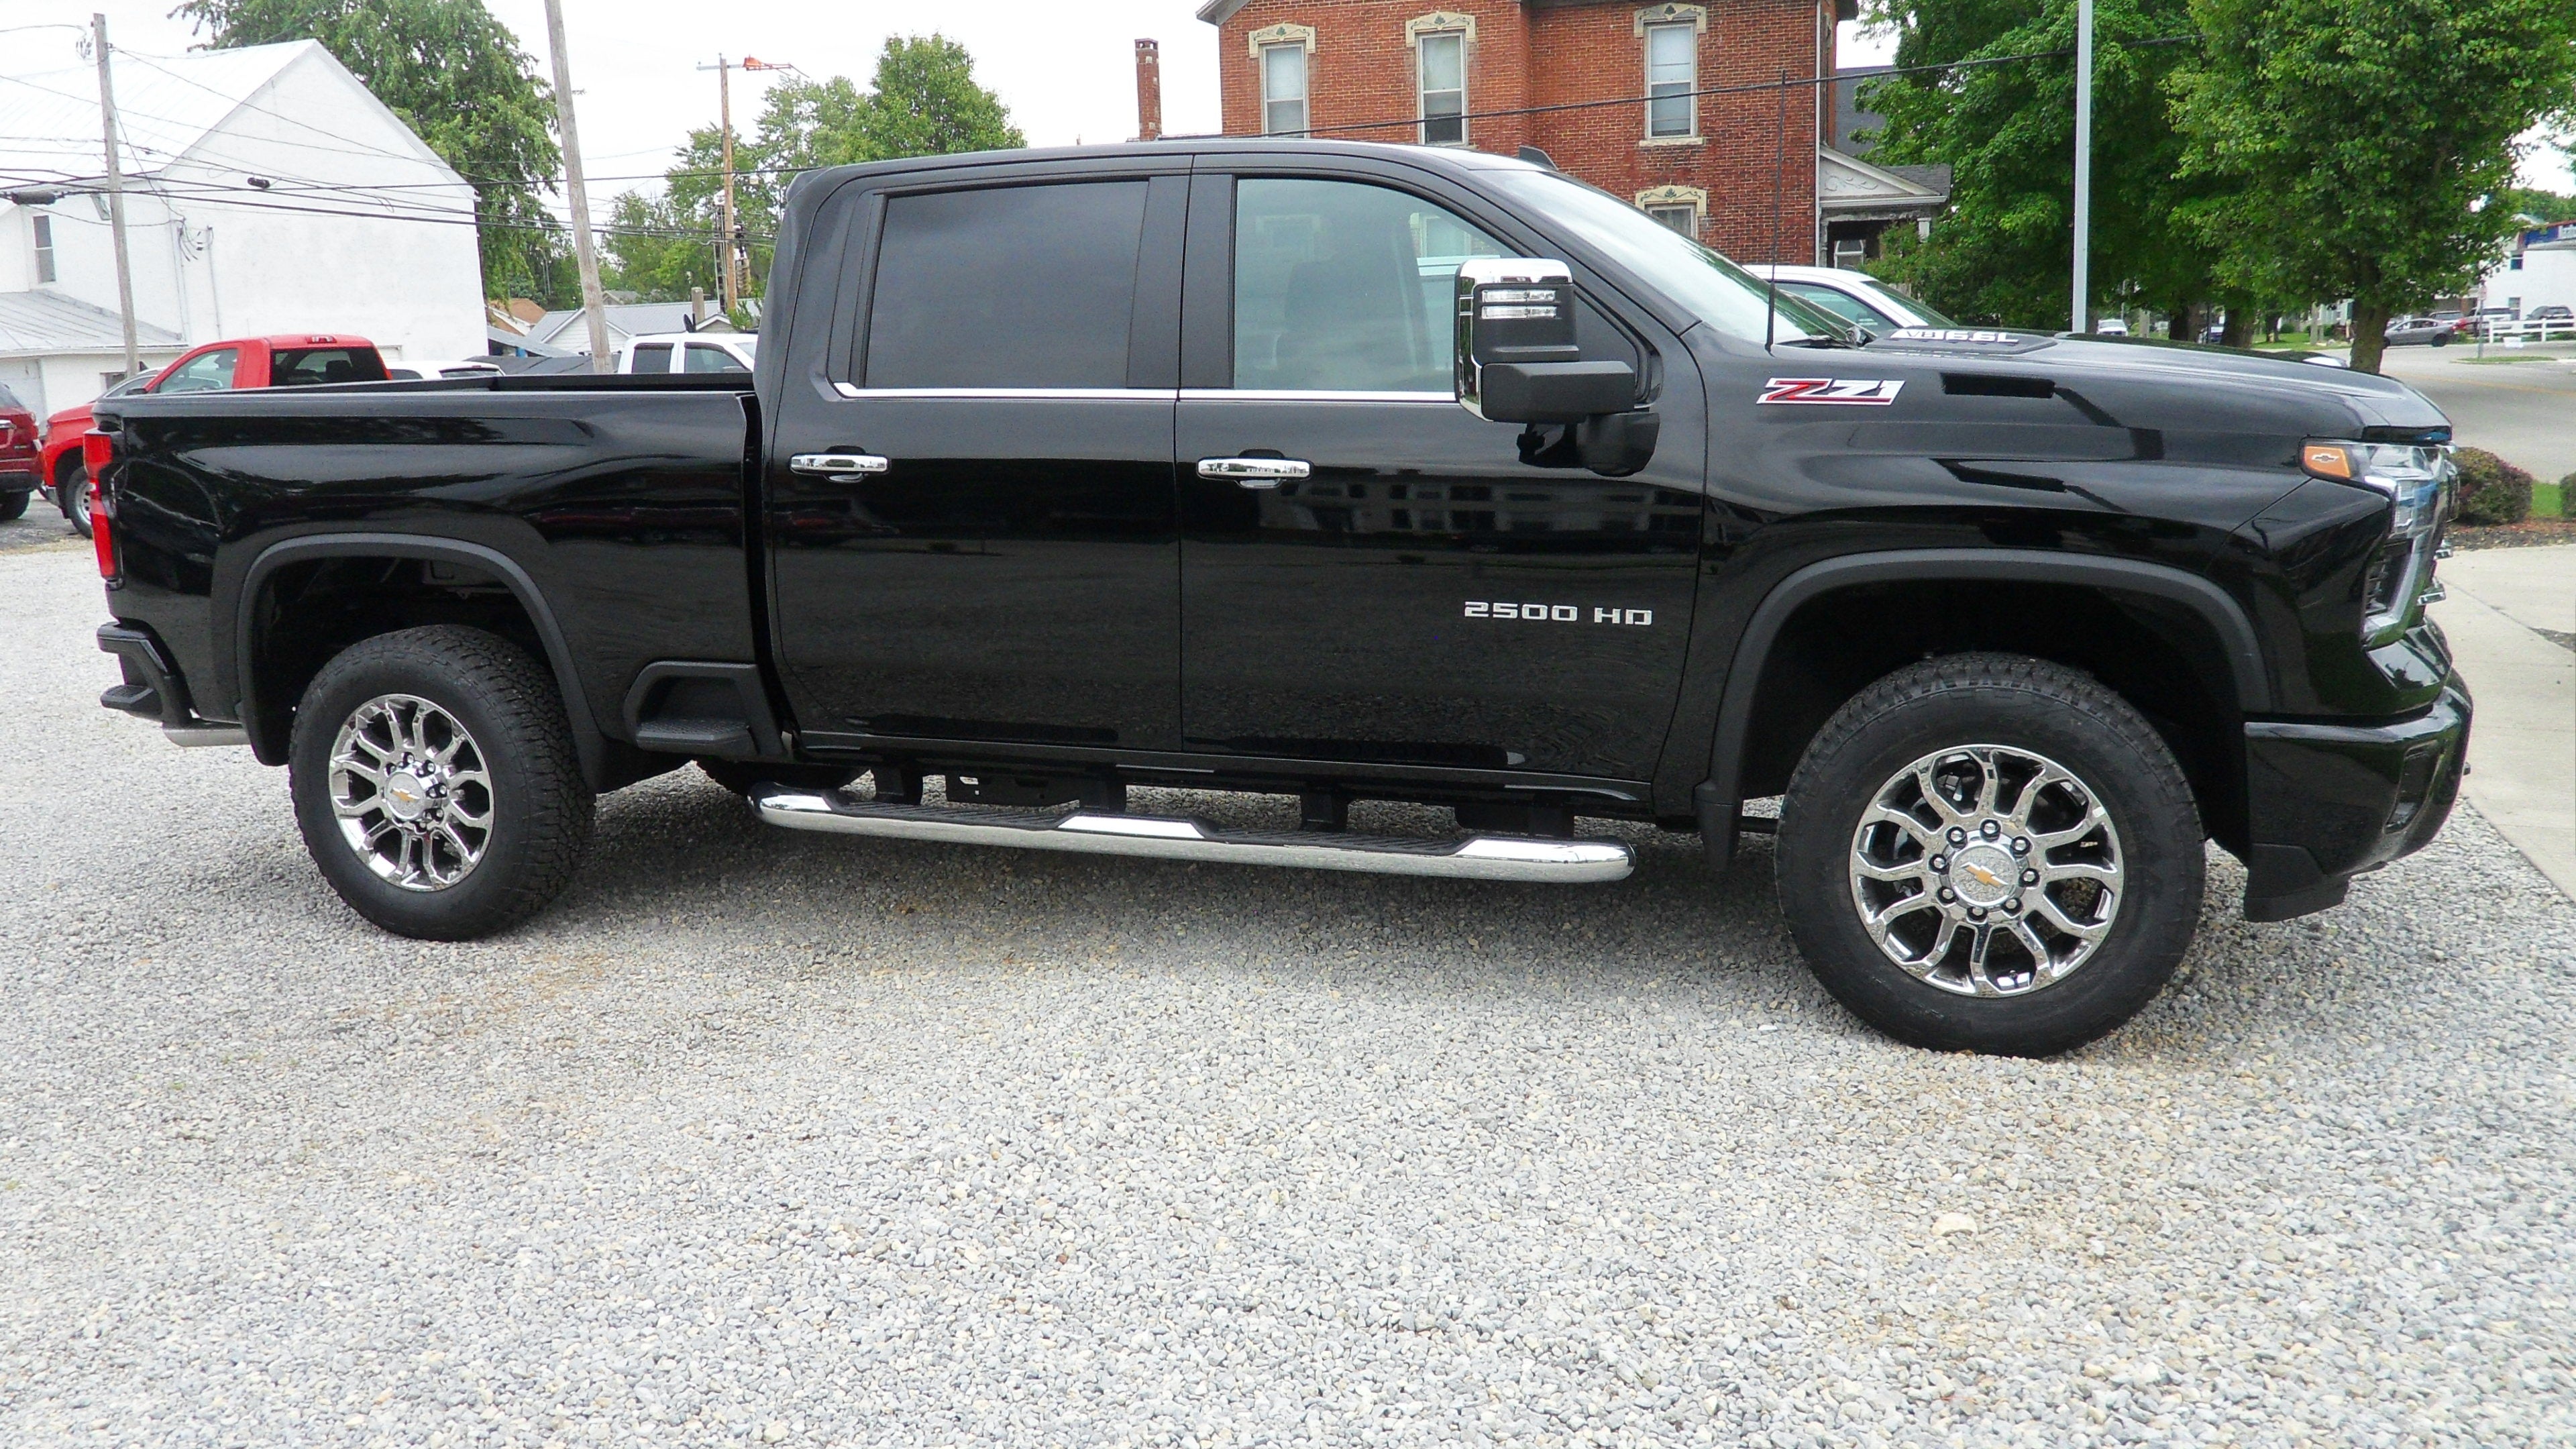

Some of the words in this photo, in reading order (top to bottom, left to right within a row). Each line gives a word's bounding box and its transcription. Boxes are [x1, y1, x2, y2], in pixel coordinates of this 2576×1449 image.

[1945, 331, 2019, 343] 6.6L
[1756, 378, 1905, 405] Z71
[1464, 602, 1577, 621] 2500
[1594, 607, 1652, 625] HD
